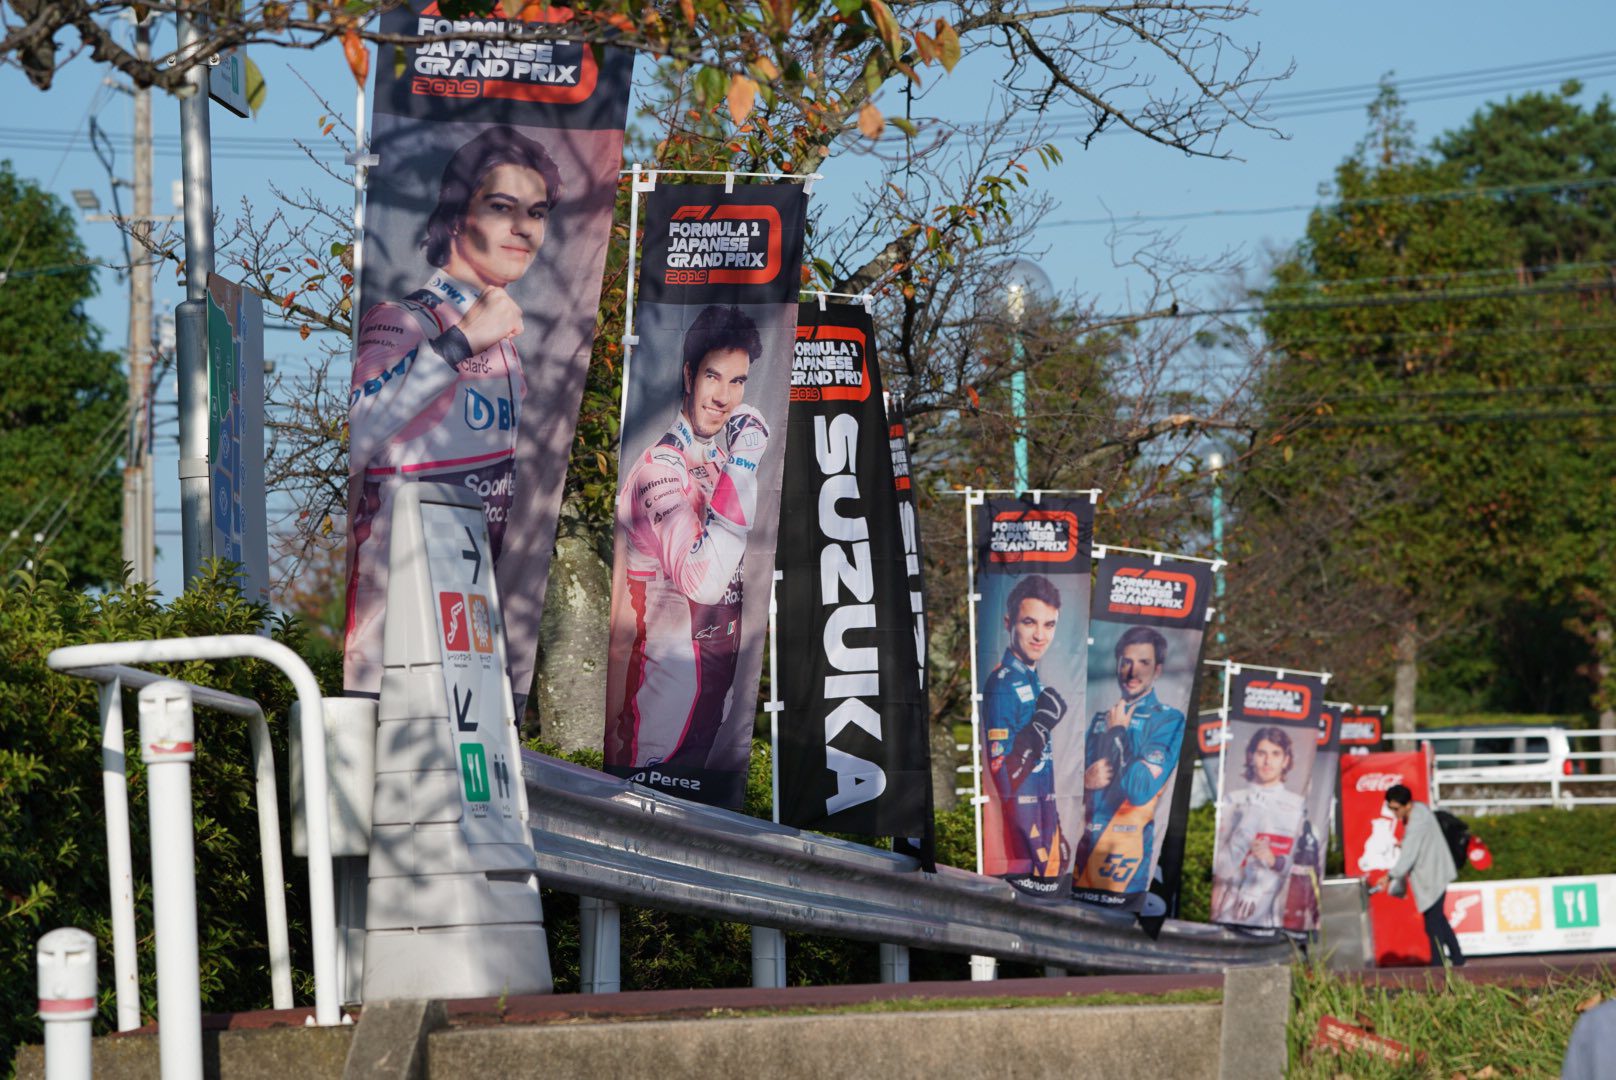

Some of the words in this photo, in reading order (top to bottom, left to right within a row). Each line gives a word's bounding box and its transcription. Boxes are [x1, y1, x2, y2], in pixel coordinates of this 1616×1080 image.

[416, 39, 553, 63] JAPANESE
[414, 56, 509, 78] GRAND
[512, 61, 577, 84] PRIX
[412, 77, 480, 97] 2019
[669, 221, 748, 237] FORMULA
[750, 222, 760, 237] 1
[668, 237, 749, 252] JAPANESE
[667, 252, 723, 268] GRAND
[724, 252, 764, 268] PRIX
[665, 269, 707, 284] 2019
[795, 341, 849, 357] ORMULA
[849, 342, 858, 357] 1
[792, 356, 853, 371] APANESE
[640, 477, 680, 496] infinitum
[992, 521, 1054, 532] FORMULA
[991, 541, 1035, 552] GRAND
[1036, 541, 1067, 552] PRIX
[1112, 575, 1172, 591] FORMULA
[1110, 594, 1153, 607] GRAND
[1154, 597, 1183, 610] PRIX
[814, 413, 887, 816] SUZUKA
[649, 771, 701, 791] Perez
[1099, 854, 1139, 883] 55
